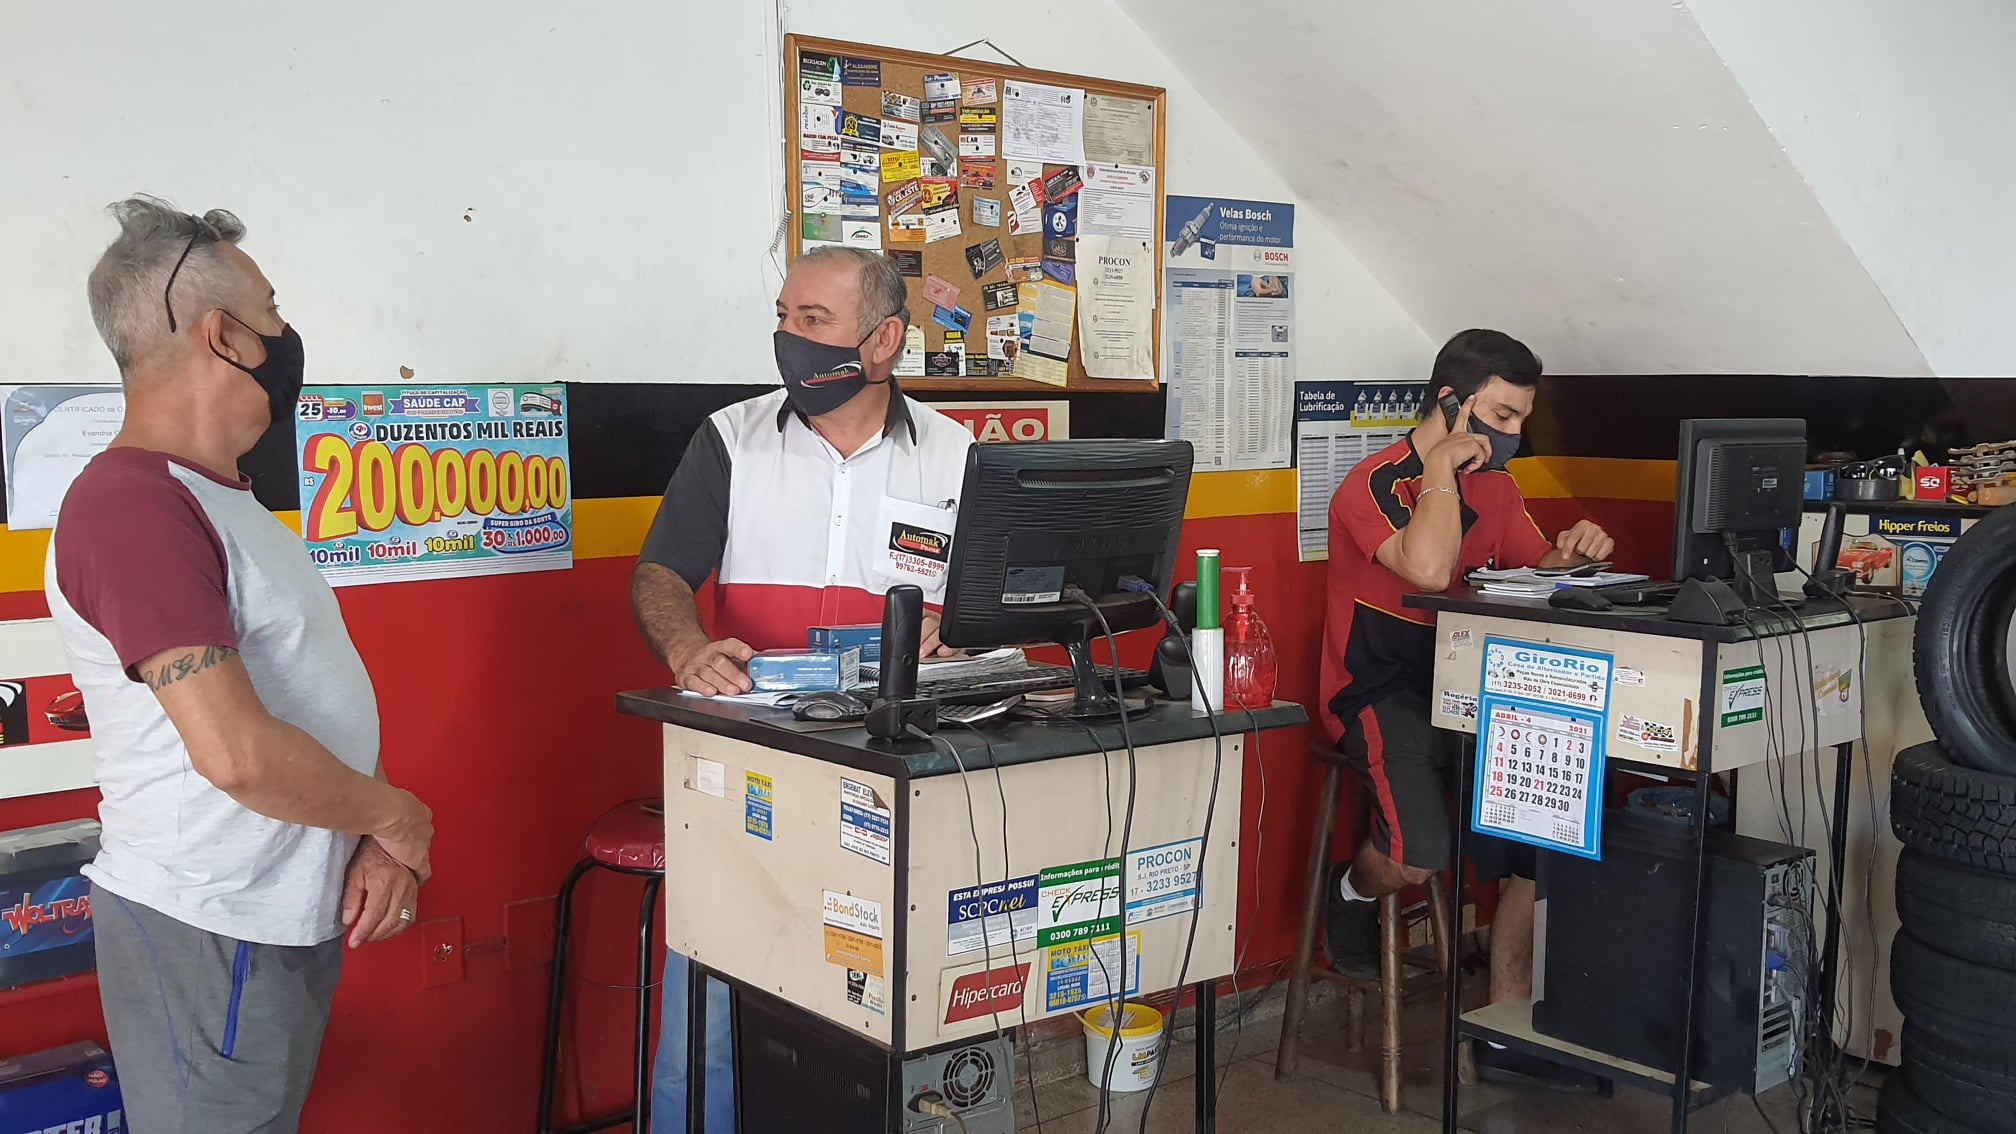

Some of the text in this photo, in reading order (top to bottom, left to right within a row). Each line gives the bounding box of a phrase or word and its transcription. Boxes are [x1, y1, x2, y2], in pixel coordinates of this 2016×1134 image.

[1219, 207, 1272, 221] Velas Bosch
[1219, 233, 1256, 242] performance
[1098, 256, 1131, 266] PROCON
[1264, 251, 1289, 262] BOSCH
[813, 367, 850, 380] Automak
[403, 396, 466, 408] SAÚDE CAP
[1299, 390, 1336, 401] Tabela de
[300, 402, 322, 417] 25
[1299, 402, 1345, 413] Lubrificação
[376, 420, 563, 442] DUZENTOS MIL REAIS
[490, 519, 510, 527] SUPER
[509, 519, 525, 527] GIRO
[533, 514, 552, 524] SORTE
[1879, 519, 1951, 533] Hipper Freios
[424, 535, 475, 552] 10mil
[483, 530, 506, 547] 30
[900, 528, 940, 548] Automak
[310, 546, 360, 564] 10mil
[367, 541, 417, 558] 10mil
[1514, 651, 1600, 673] GiroRio
[1507, 661, 1525, 669] Casa
[1536, 665, 1573, 676] Alternador
[1580, 671, 1605, 681] Partida
[1491, 680, 1502, 688] (17)
[1503, 680, 1542, 694] 3235-2052
[1443, 691, 1477, 702] Rogério
[1494, 711, 1519, 721] ABRIL
[1568, 725, 1588, 735] 2021
[1554, 738, 1584, 754] 1 2 3
[1496, 742, 1585, 769] 4 5 6 7 8 9 10
[1494, 757, 1583, 784] 11 12 13 14 15 16 17
[1492, 771, 1582, 800] 18 19 20 21 22 23 24
[1490, 785, 1569, 812] 25 26 27 28 29 30
[1137, 847, 1192, 871] PROCON
[1040, 868, 1083, 881] Informações
[1084, 866, 1100, 876] para
[1148, 870, 1160, 879] RIO
[1160, 866, 1179, 876] PRETO
[1183, 863, 1191, 871] SP
[953, 891, 971, 902] ESTA
[1007, 878, 1035, 891] POSSUI
[1130, 887, 1139, 897] 17
[1146, 877, 1171, 893] 3233
[1173, 871, 1198, 887] 9527
[1041, 887, 1072, 898] CHECK
[1051, 886, 1120, 910] EXPRESS
[833, 898, 879, 924] BondStock
[1050, 929, 1071, 941] 0300
[1072, 926, 1089, 937] 789
[1051, 947, 1072, 957] MOTO
[952, 976, 1025, 1010] Hipercard
